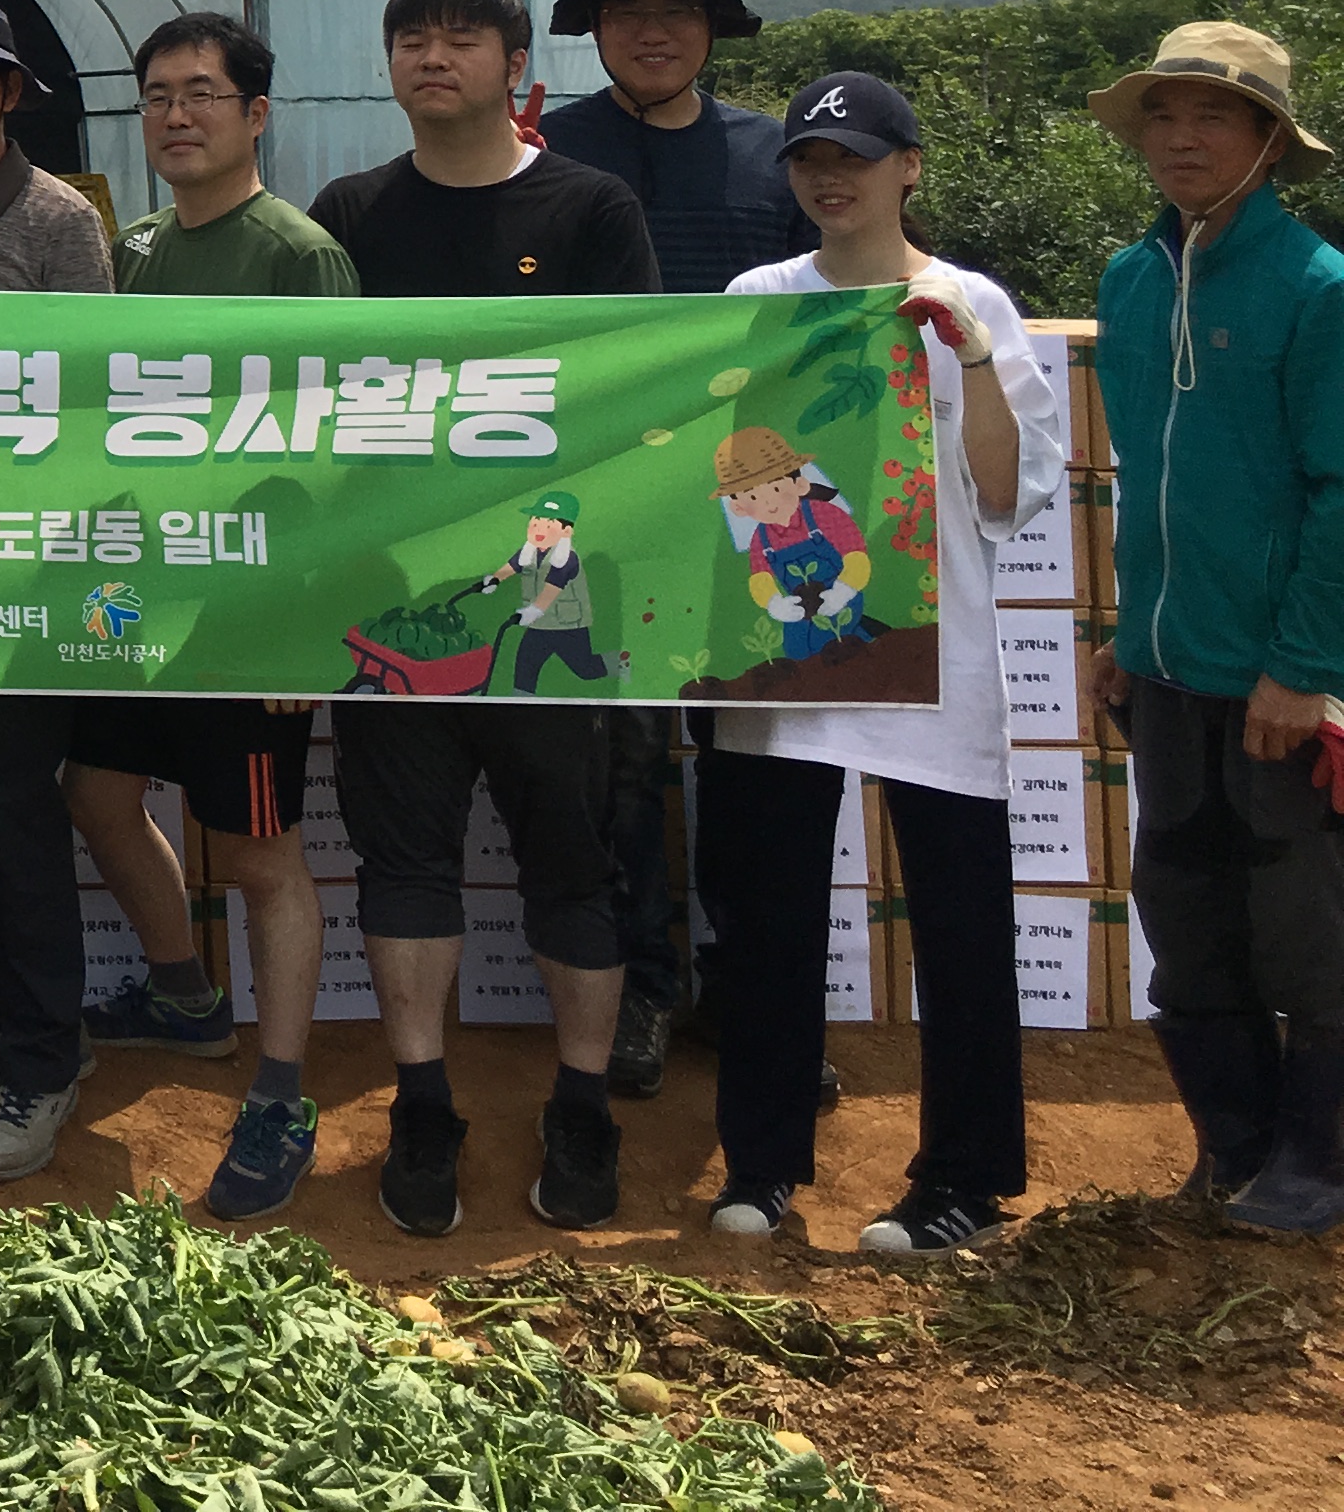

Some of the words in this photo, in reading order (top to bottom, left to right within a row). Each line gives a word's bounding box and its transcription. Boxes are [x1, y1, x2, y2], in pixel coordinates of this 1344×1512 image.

[803, 85, 847, 121] A
[124, 238, 152, 256] adidas
[105, 352, 561, 458] 봉사활동
[158, 510, 269, 566] 일대
[58, 641, 167, 664] 인천도시공사
